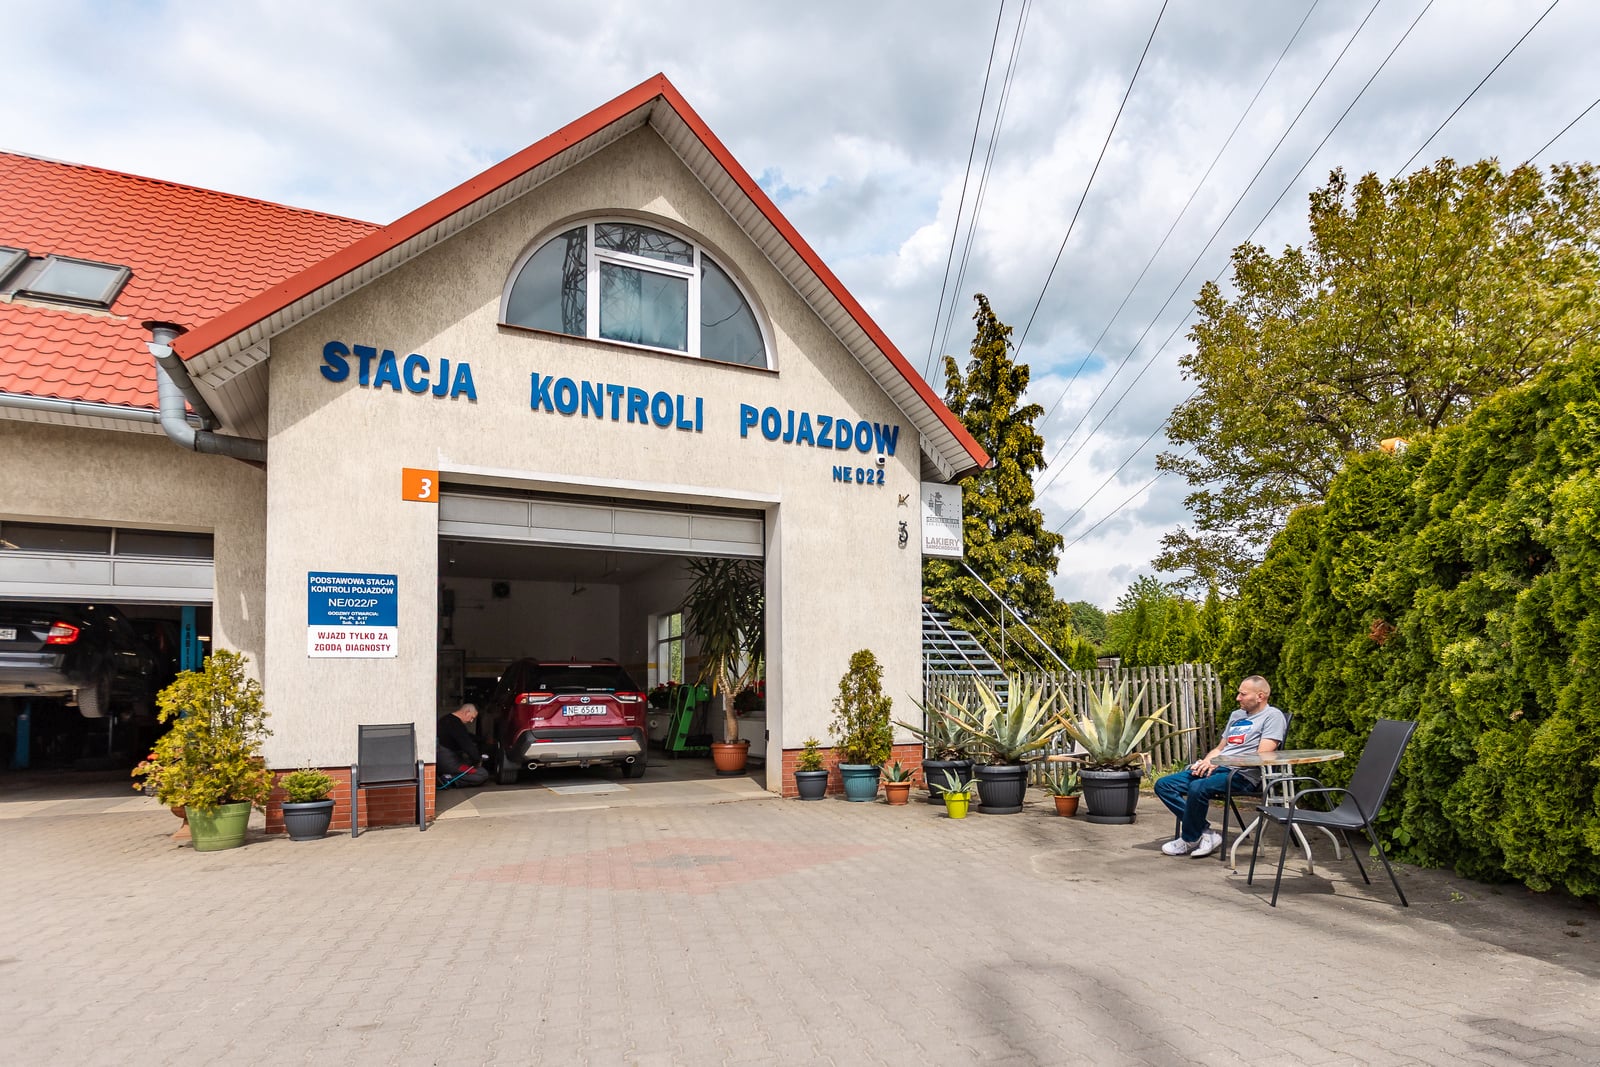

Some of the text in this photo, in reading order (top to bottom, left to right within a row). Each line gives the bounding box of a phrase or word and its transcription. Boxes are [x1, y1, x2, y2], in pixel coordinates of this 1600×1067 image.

[320, 341, 899, 457] STACJA KONTROLI POJAZDOW
[833, 466, 885, 485] NE 022
[417, 478, 432, 499] 3
[926, 537, 960, 546] LAKIERY
[310, 576, 395, 586] PODSTAWOWA STACJA
[352, 586, 394, 594] POJAZDÓW
[328, 598, 378, 607] NE/022/P
[317, 632, 346, 640] WJAZD
[350, 632, 376, 640] TYLKO
[314, 643, 391, 653] ZGODĄ DIAGNOSTY
[568, 706, 604, 714] NE 6561J
